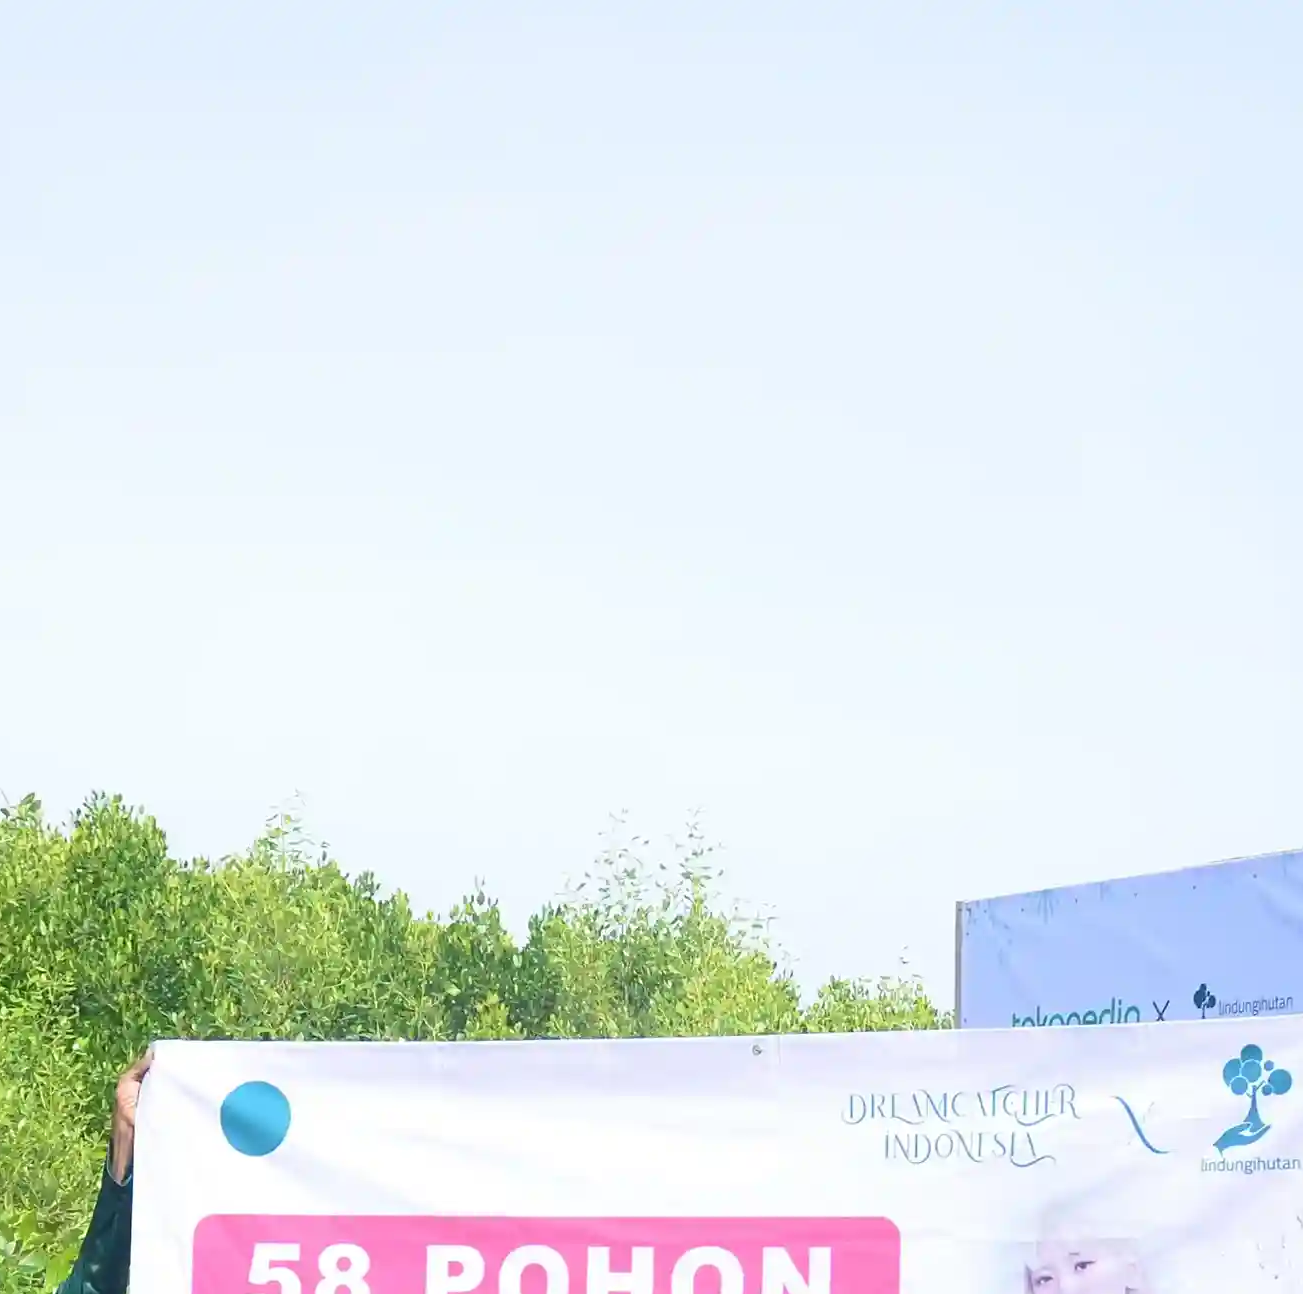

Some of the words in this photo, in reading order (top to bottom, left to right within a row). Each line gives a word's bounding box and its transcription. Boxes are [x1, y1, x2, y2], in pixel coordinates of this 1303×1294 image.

[1218, 995, 1294, 1016] lindungihutan
[841, 1083, 1082, 1127] DREAMCATCHER
[884, 1130, 1056, 1168] INDONESIA
[1200, 1156, 1302, 1175] lindungihutan
